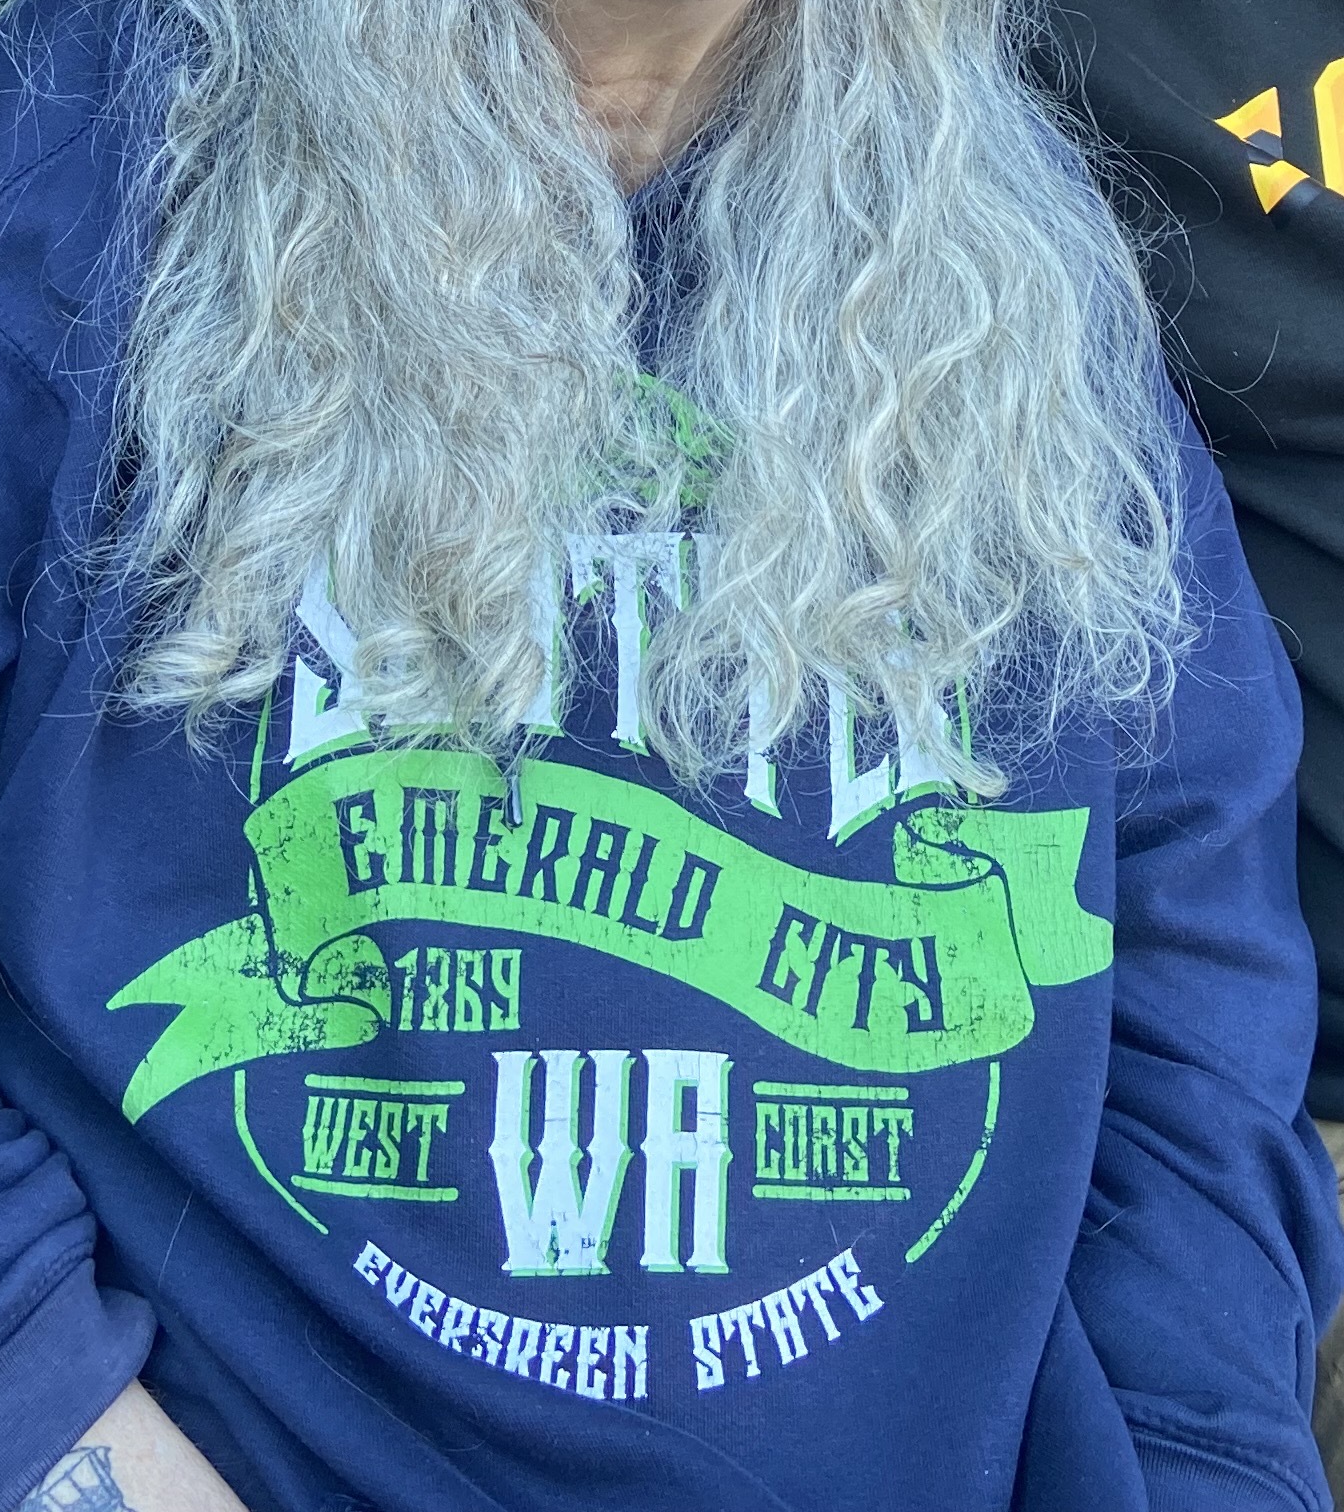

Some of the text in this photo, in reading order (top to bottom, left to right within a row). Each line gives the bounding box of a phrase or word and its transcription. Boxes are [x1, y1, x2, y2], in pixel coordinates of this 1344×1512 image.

[333, 786, 945, 1035] EMERALD CITY
[394, 947, 523, 1032] 1869
[302, 1095, 449, 1183] WEST
[488, 1049, 735, 1277] WA
[755, 1102, 914, 1182] COAST
[689, 1247, 885, 1391] STATE
